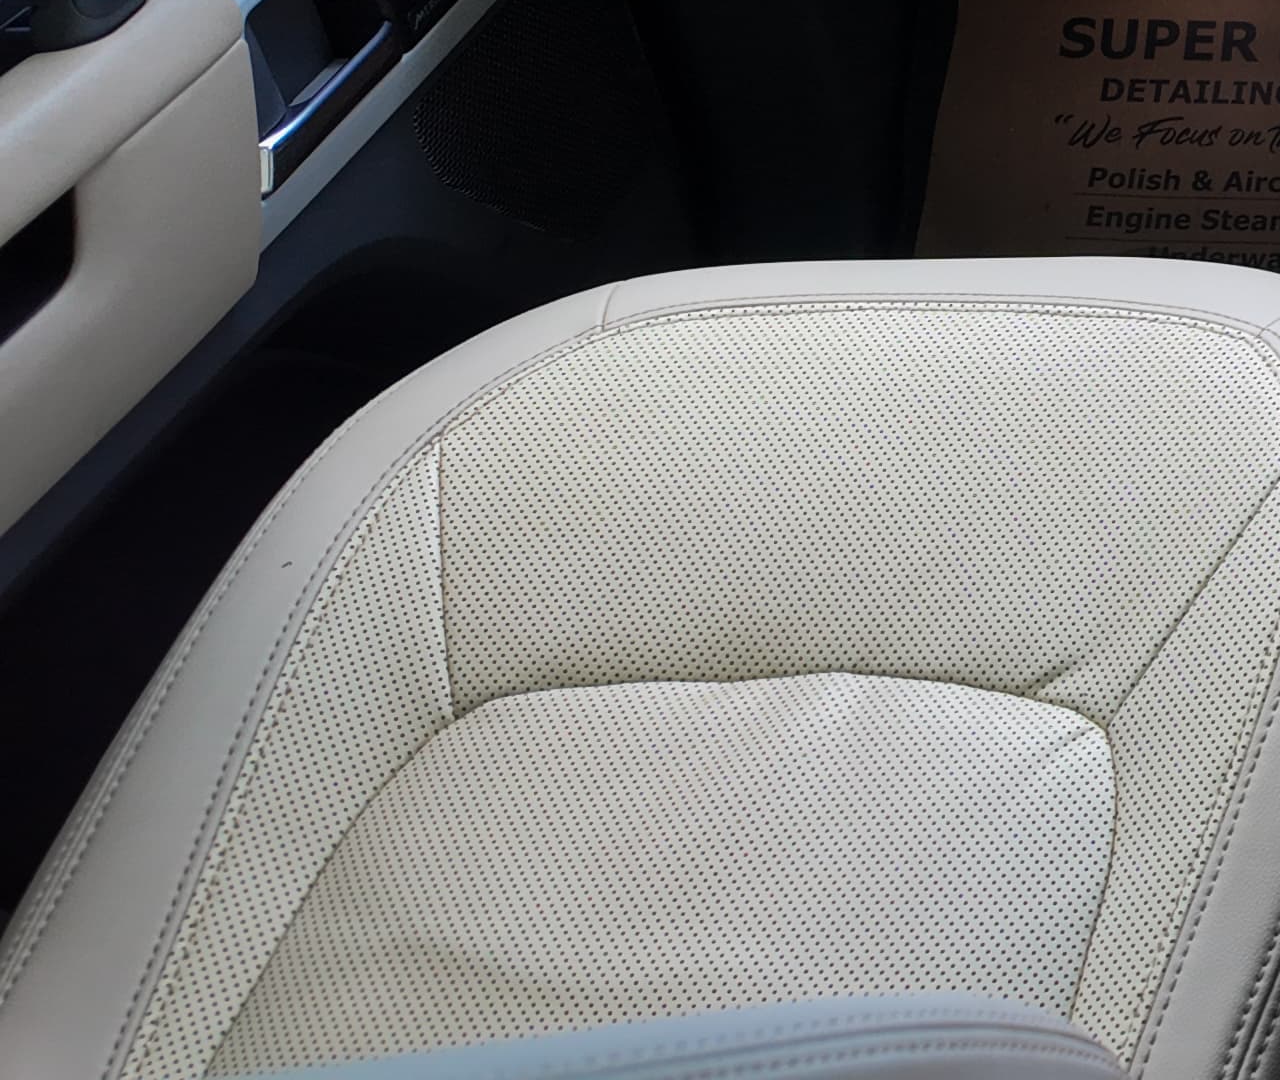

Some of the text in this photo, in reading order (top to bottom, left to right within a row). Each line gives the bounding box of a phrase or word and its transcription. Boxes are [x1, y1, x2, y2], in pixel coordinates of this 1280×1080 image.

[1058, 17, 1257, 63] SUPER
[1131, 116, 1222, 151] Focus
[1229, 128, 1263, 147] on
[1088, 168, 1180, 191] Polish
[1192, 171, 1212, 192] &
[1086, 206, 1190, 234] Engine
